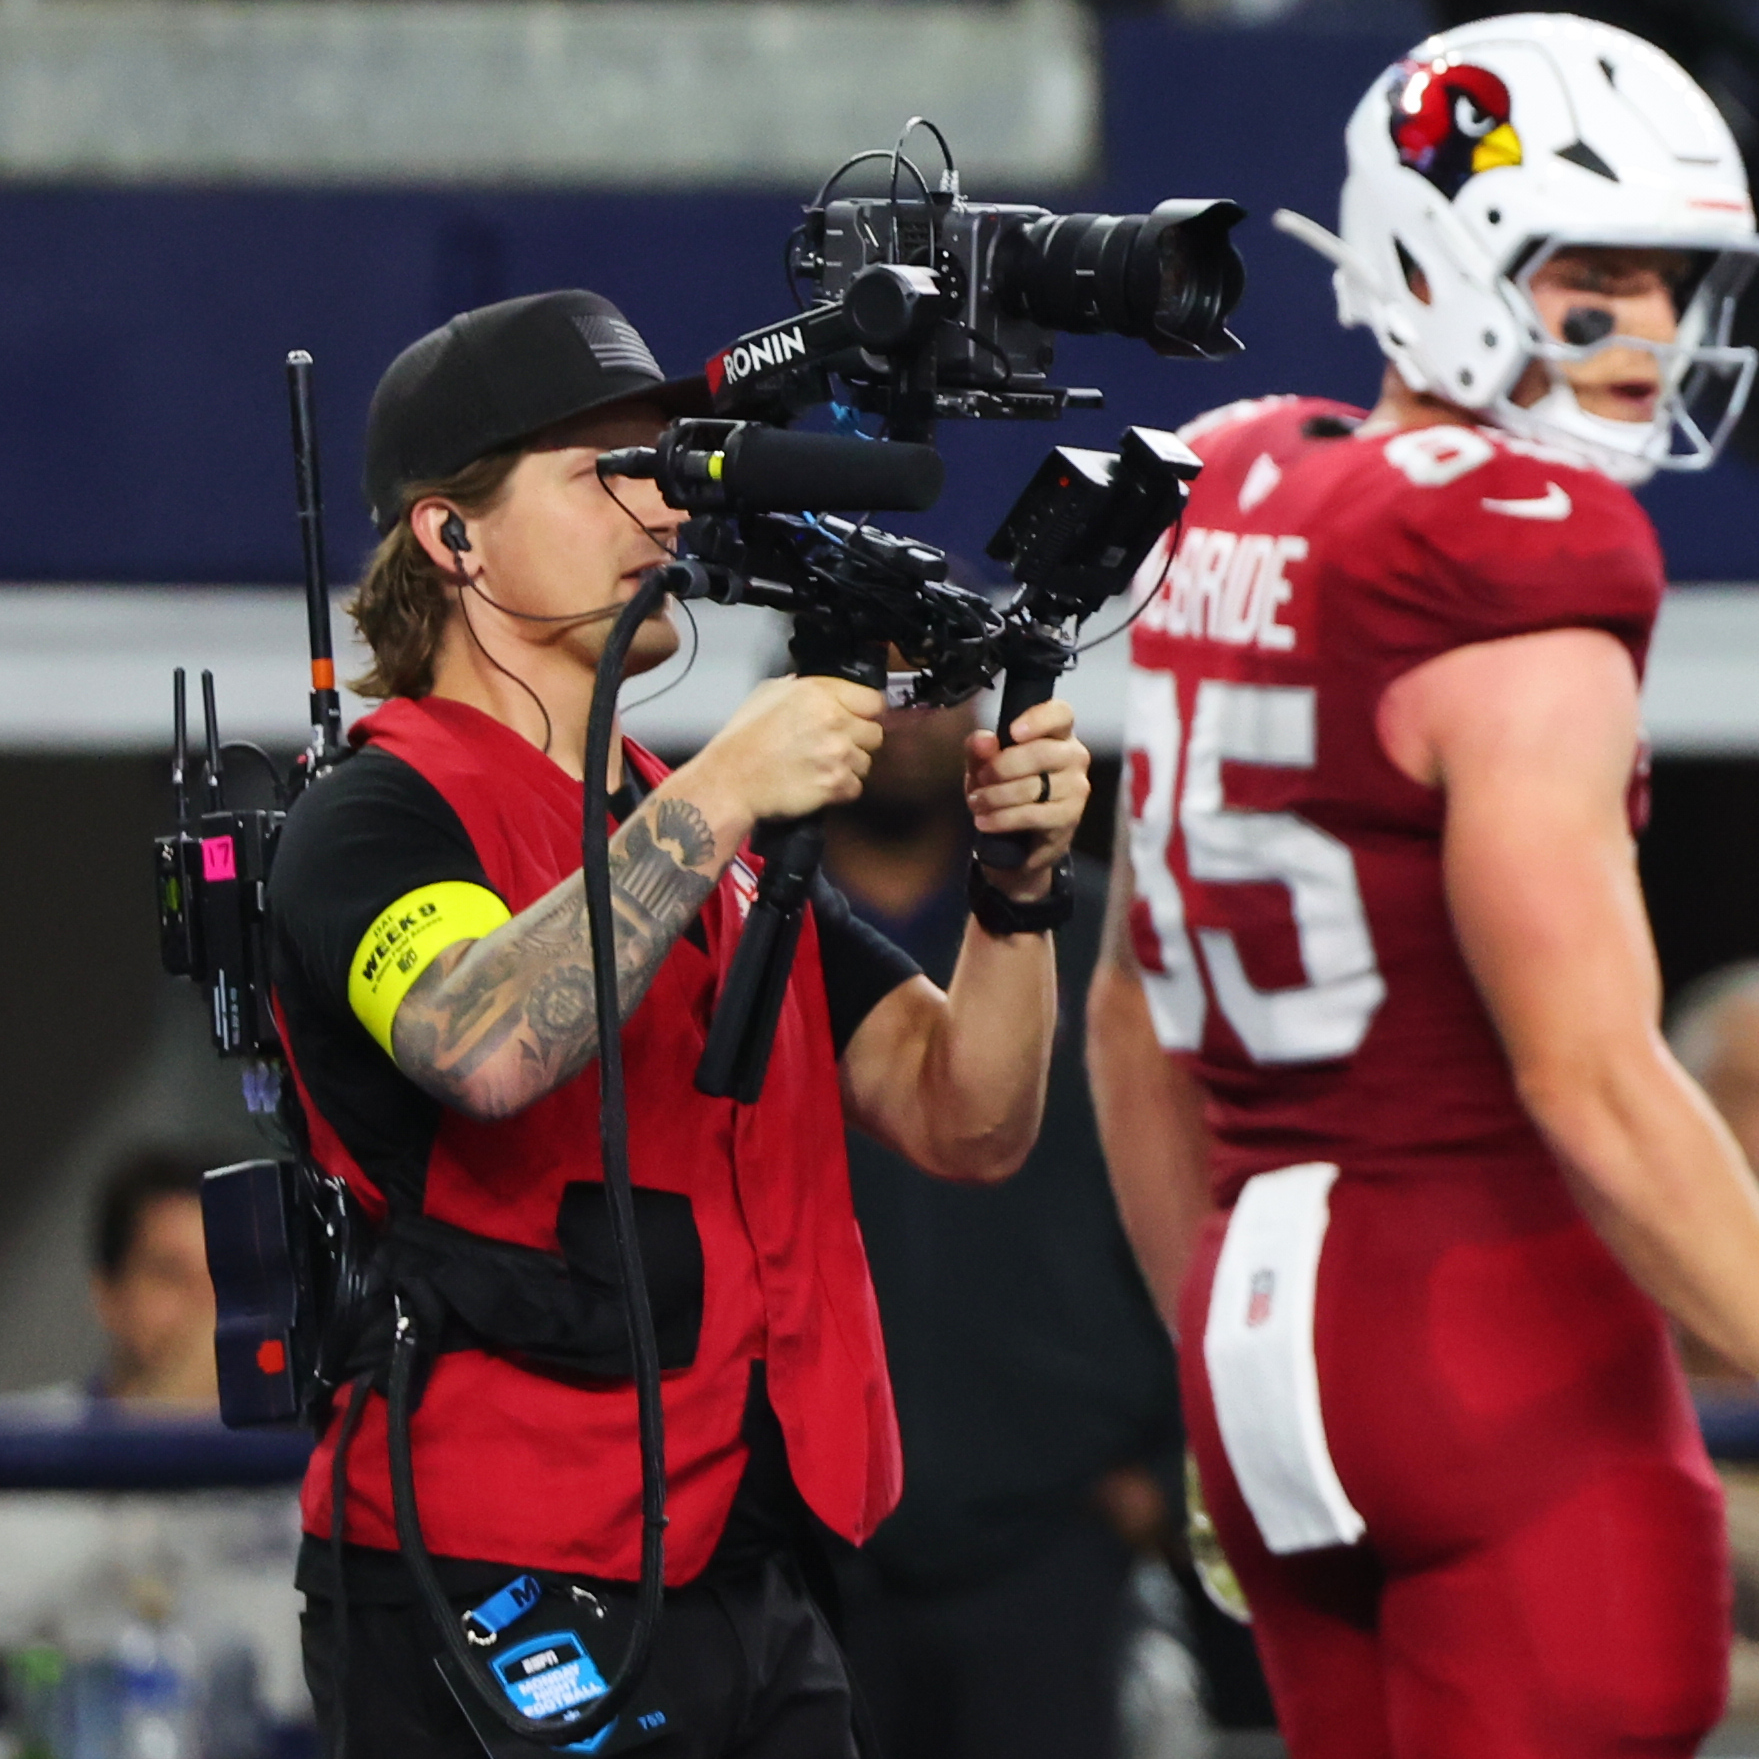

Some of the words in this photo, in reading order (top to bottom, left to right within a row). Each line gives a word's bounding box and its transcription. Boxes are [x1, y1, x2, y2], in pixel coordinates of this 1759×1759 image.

[723, 326, 806, 384] RONIN
[363, 912, 417, 982] WEEK
[518, 1664, 580, 1695] MONDAY
[521, 1648, 559, 1675] ESPN
[523, 1682, 602, 1718] FOOTBALL
